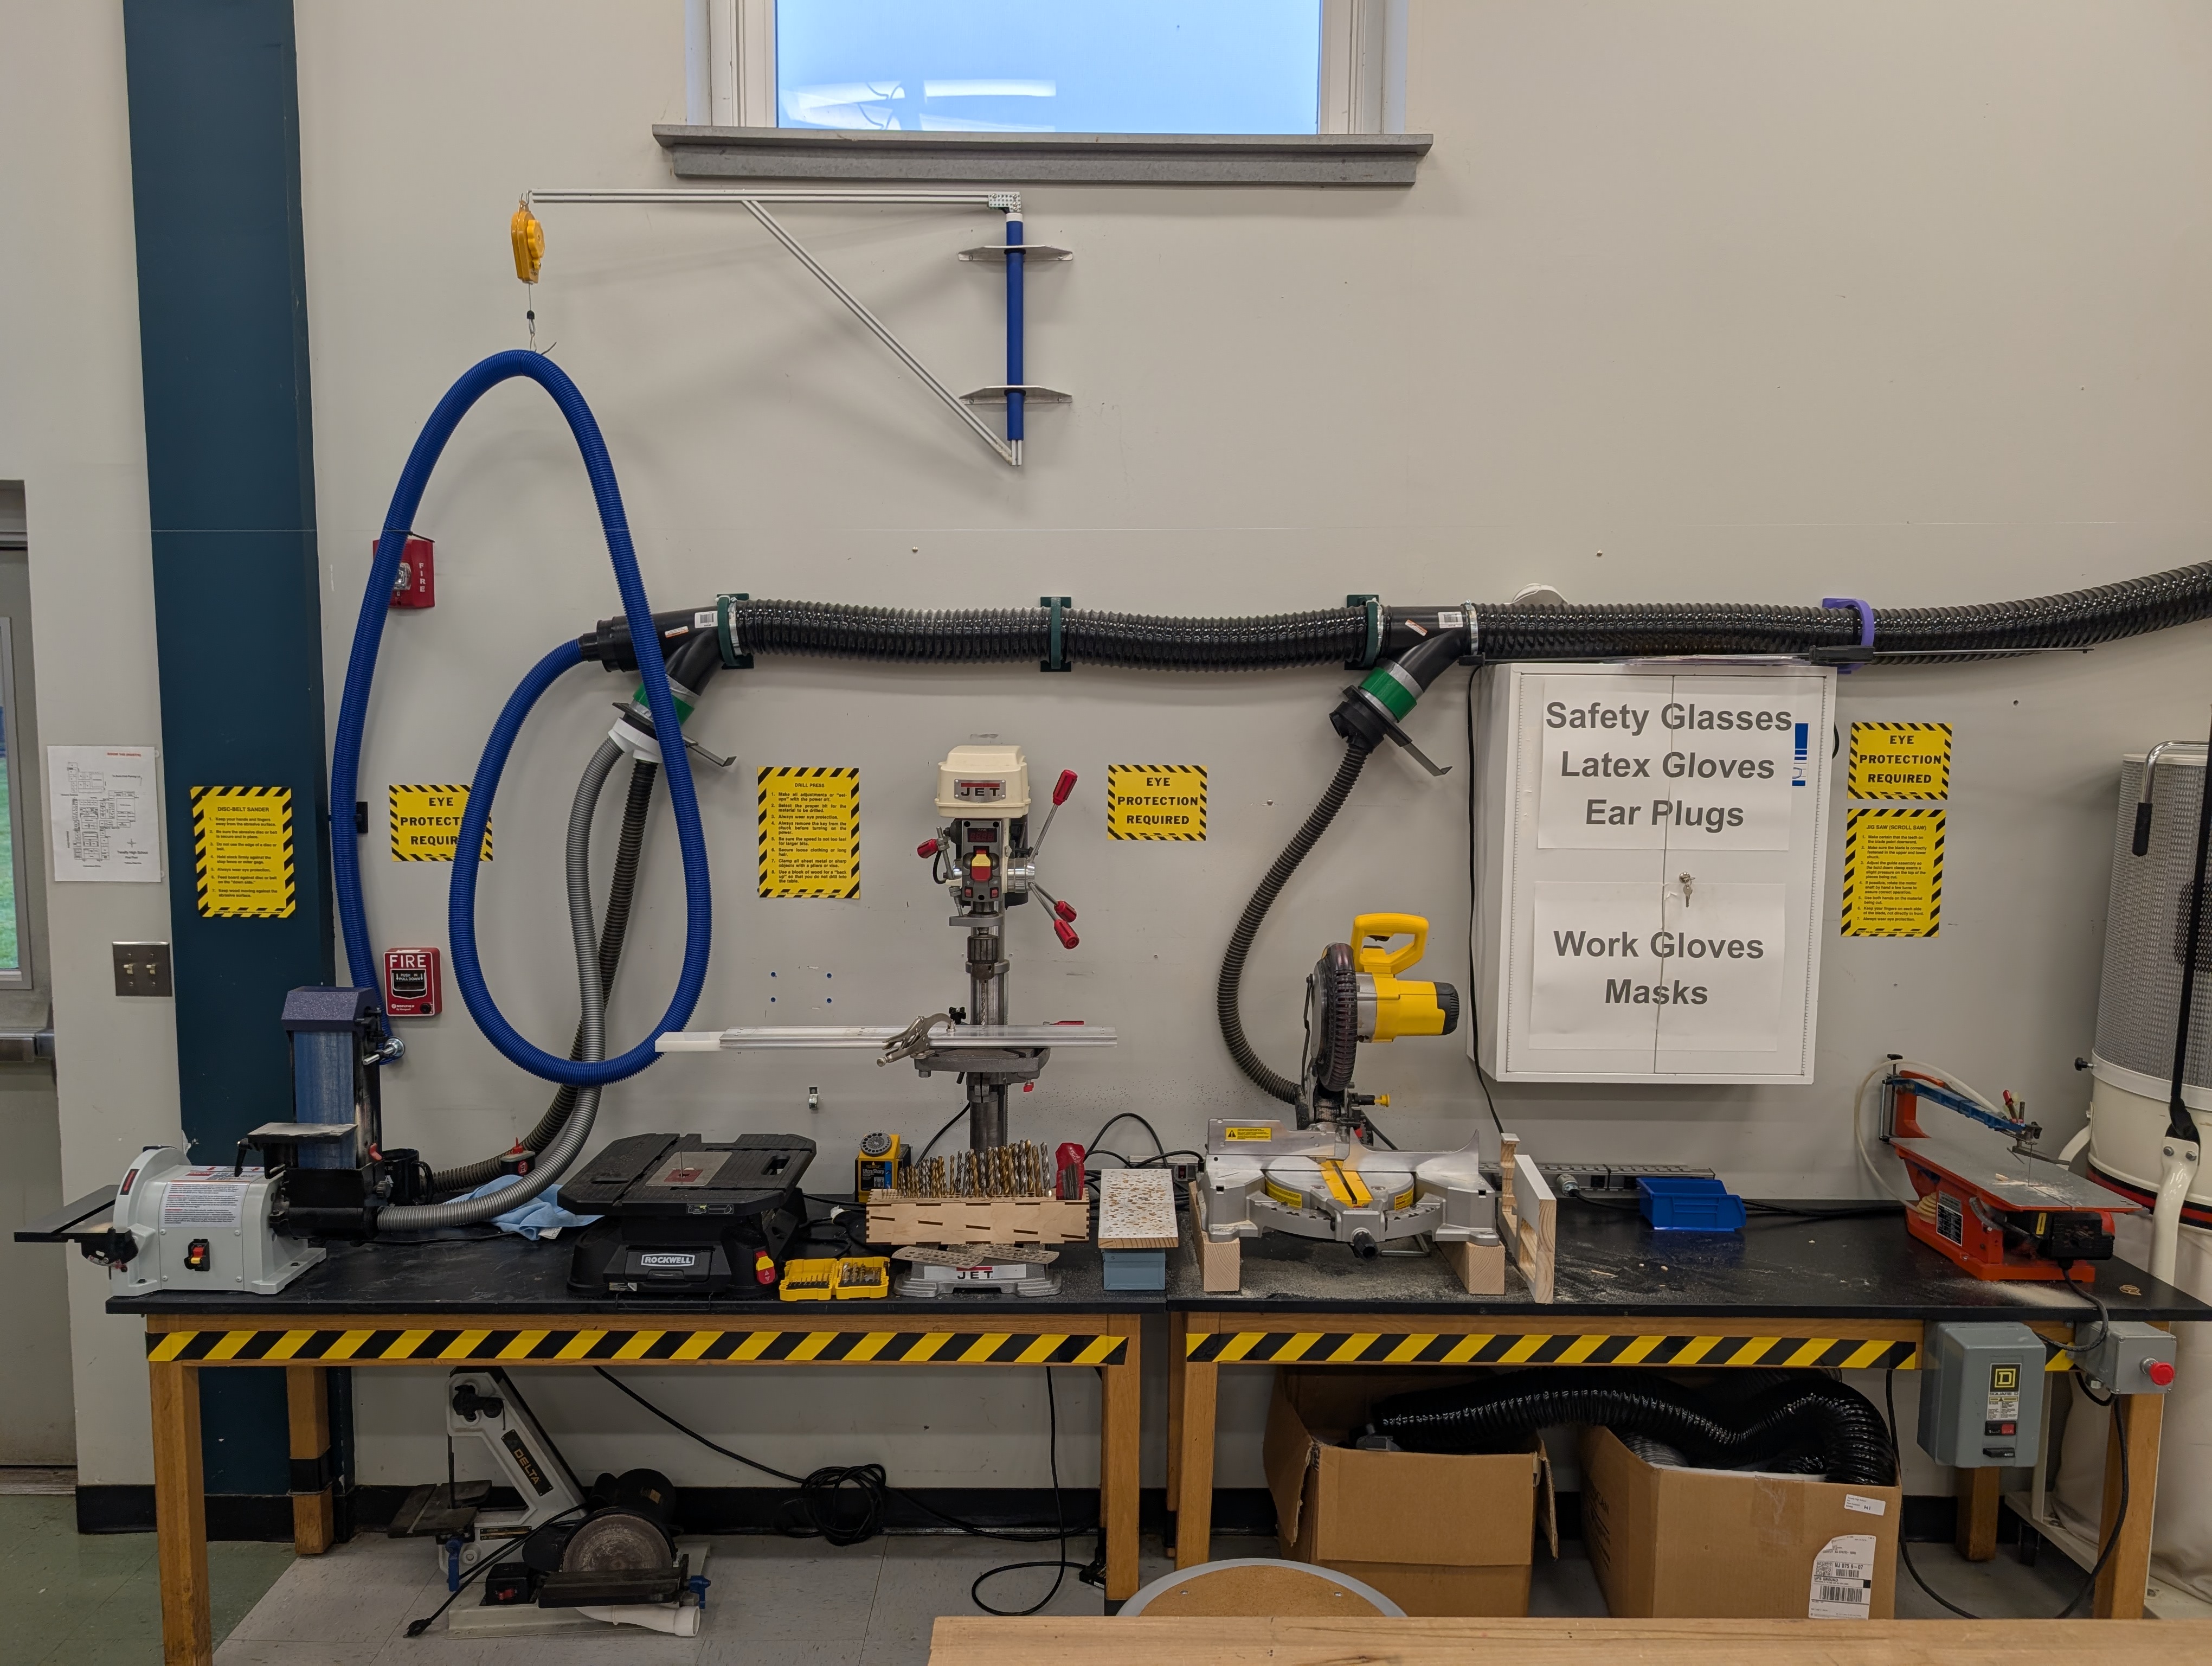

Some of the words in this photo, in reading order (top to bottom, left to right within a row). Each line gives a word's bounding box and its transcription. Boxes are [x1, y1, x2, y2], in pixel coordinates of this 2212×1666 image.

[1546, 702, 1649, 735] Safety
[1661, 703, 1792, 731] Glasses
[1890, 735, 1914, 744] EYE
[1860, 755, 1941, 764] PROTECTION
[1561, 751, 1650, 778] Latex
[1662, 751, 1774, 779] Gloves
[1147, 778, 1170, 786] EYE
[1868, 774, 1931, 784] REQUIRED
[961, 788, 999, 796] JET
[429, 797, 453, 806] EYE
[1118, 797, 1198, 805] PROTECTION
[401, 817, 463, 825] PROTECT
[1127, 815, 1189, 825] REQUIRED
[1586, 799, 1641, 825] Ear
[1652, 800, 1744, 833] Plugs
[411, 836, 458, 846] REQUIR
[1554, 931, 1638, 957] Work
[1650, 932, 1764, 959] Gloves
[390, 955, 426, 967] FIRE
[1605, 979, 1708, 1005] Masks
[645, 1255, 691, 1265] ROCKWELL
[514, 1449, 540, 1484] DELTA
